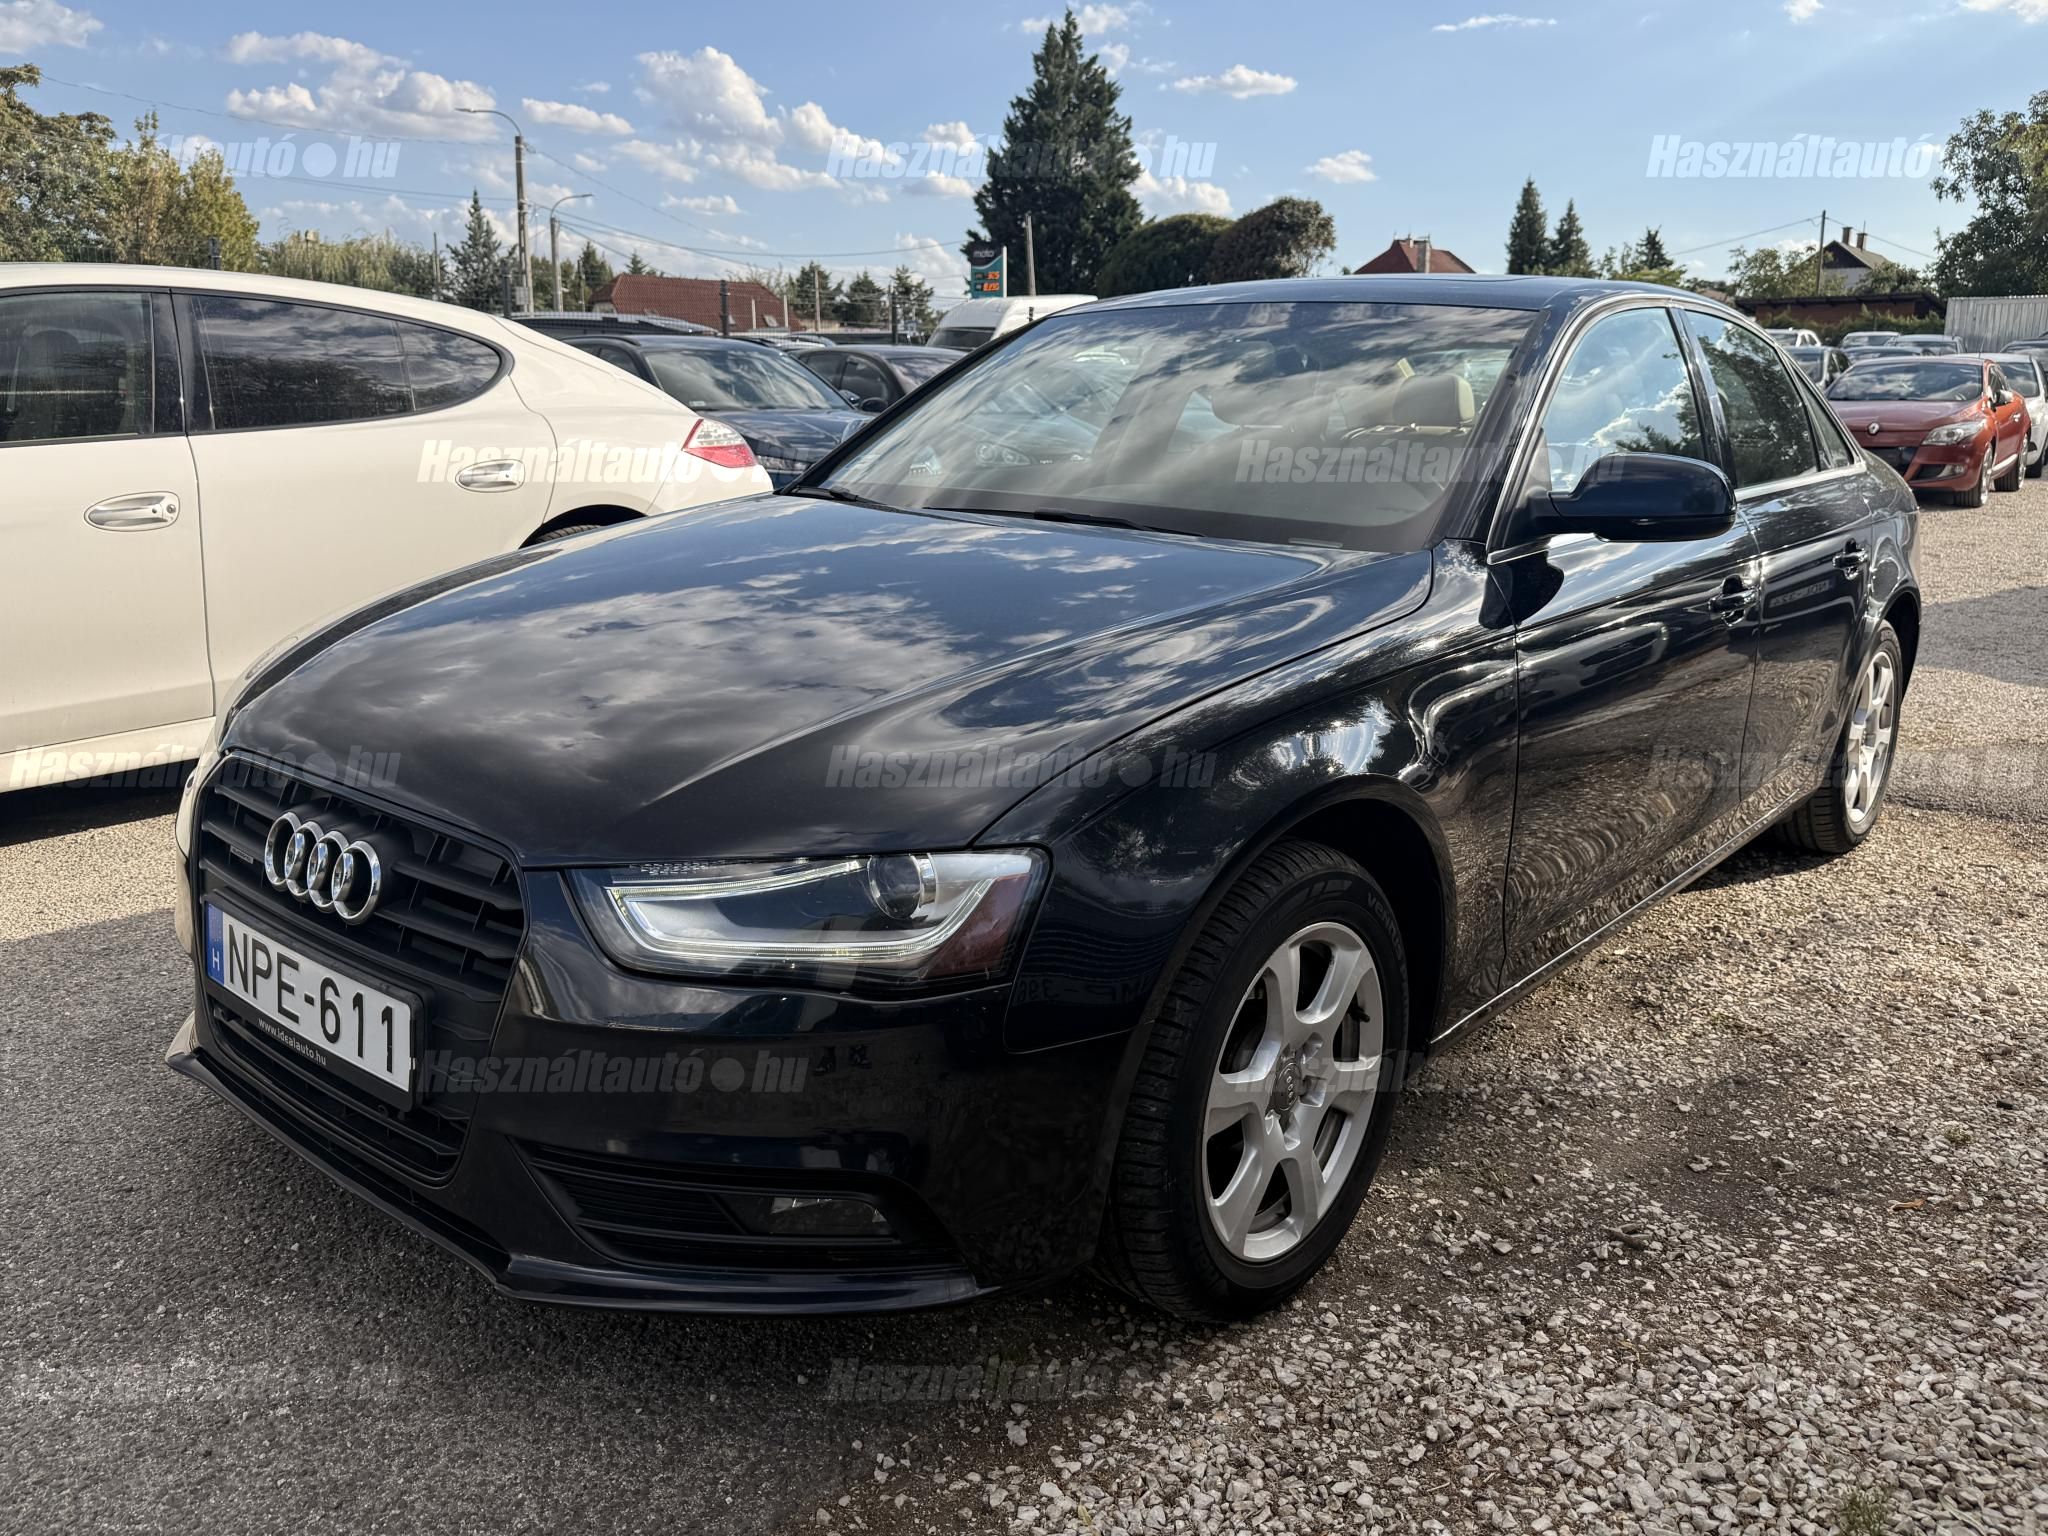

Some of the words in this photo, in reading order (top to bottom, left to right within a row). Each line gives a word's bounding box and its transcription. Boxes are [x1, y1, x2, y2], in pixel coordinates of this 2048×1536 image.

[212, 948, 220, 971] H
[228, 923, 394, 1074] NPE-611
[258, 1016, 327, 1066] www.idealauto.hu
